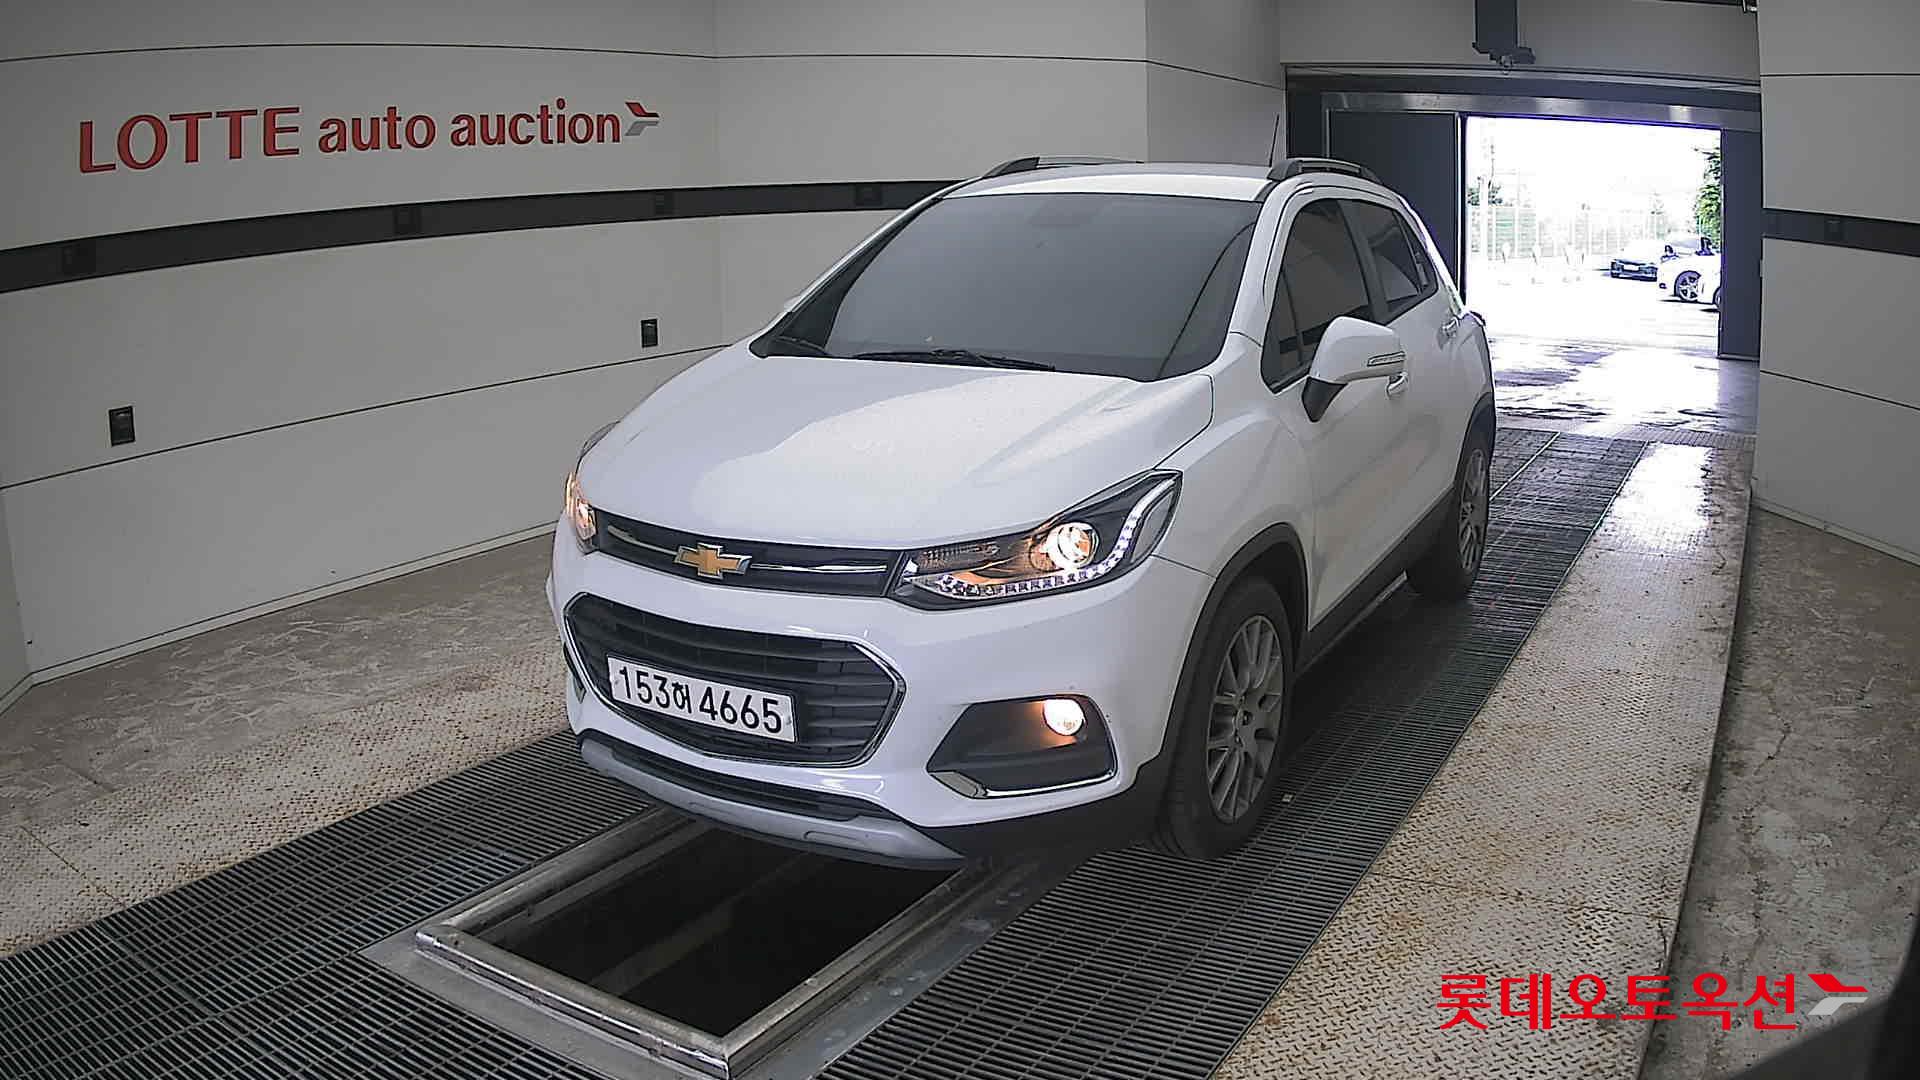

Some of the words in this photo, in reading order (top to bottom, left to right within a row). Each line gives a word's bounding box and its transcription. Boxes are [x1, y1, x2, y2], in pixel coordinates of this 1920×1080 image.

[80, 107, 301, 173] LOTTE
[317, 105, 437, 154] auto
[450, 98, 622, 146] auction
